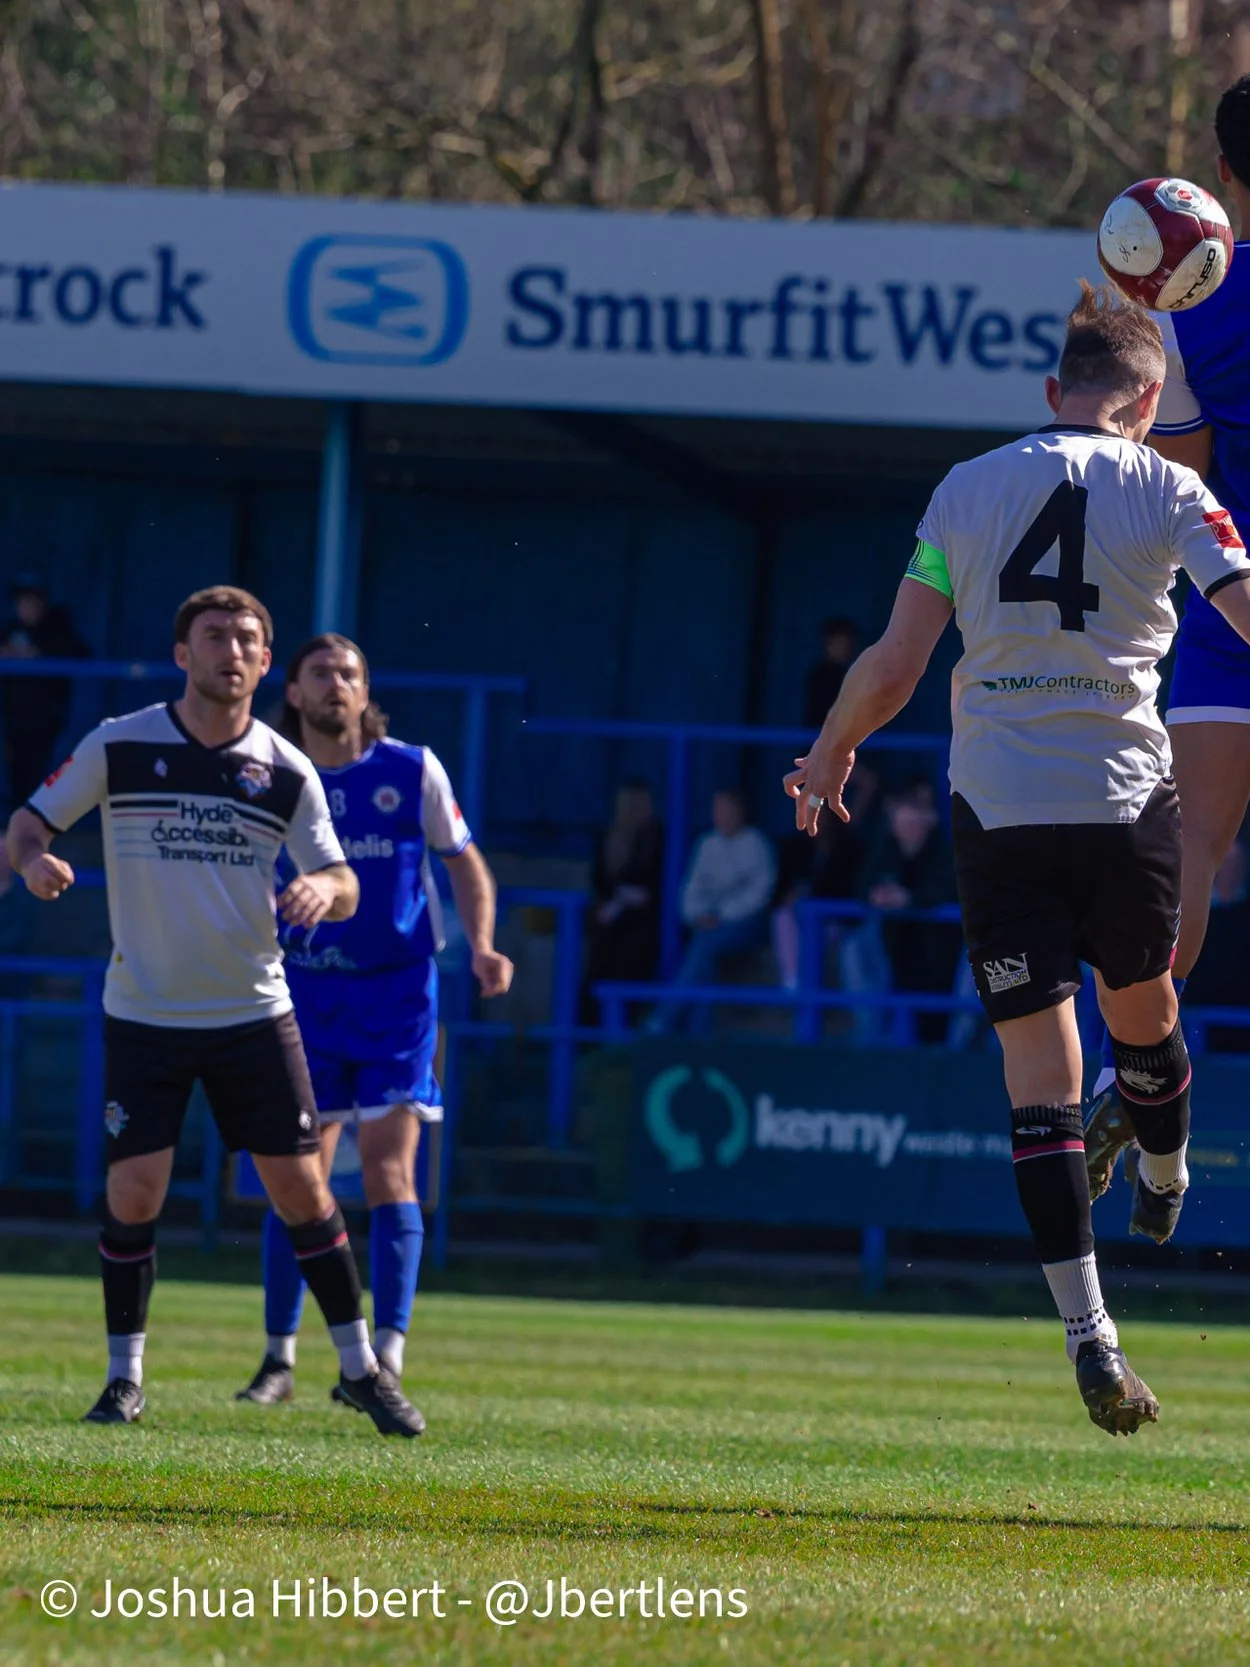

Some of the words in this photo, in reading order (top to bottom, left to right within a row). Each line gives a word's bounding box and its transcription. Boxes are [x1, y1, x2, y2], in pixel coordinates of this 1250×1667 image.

[505, 265, 1064, 373] SmurfitWes
[999, 479, 1100, 632] 4
[180, 801, 234, 825] Hyde
[157, 845, 228, 865] Transport
[230, 850, 255, 867] Ltd
[756, 1094, 906, 1169] kenny
